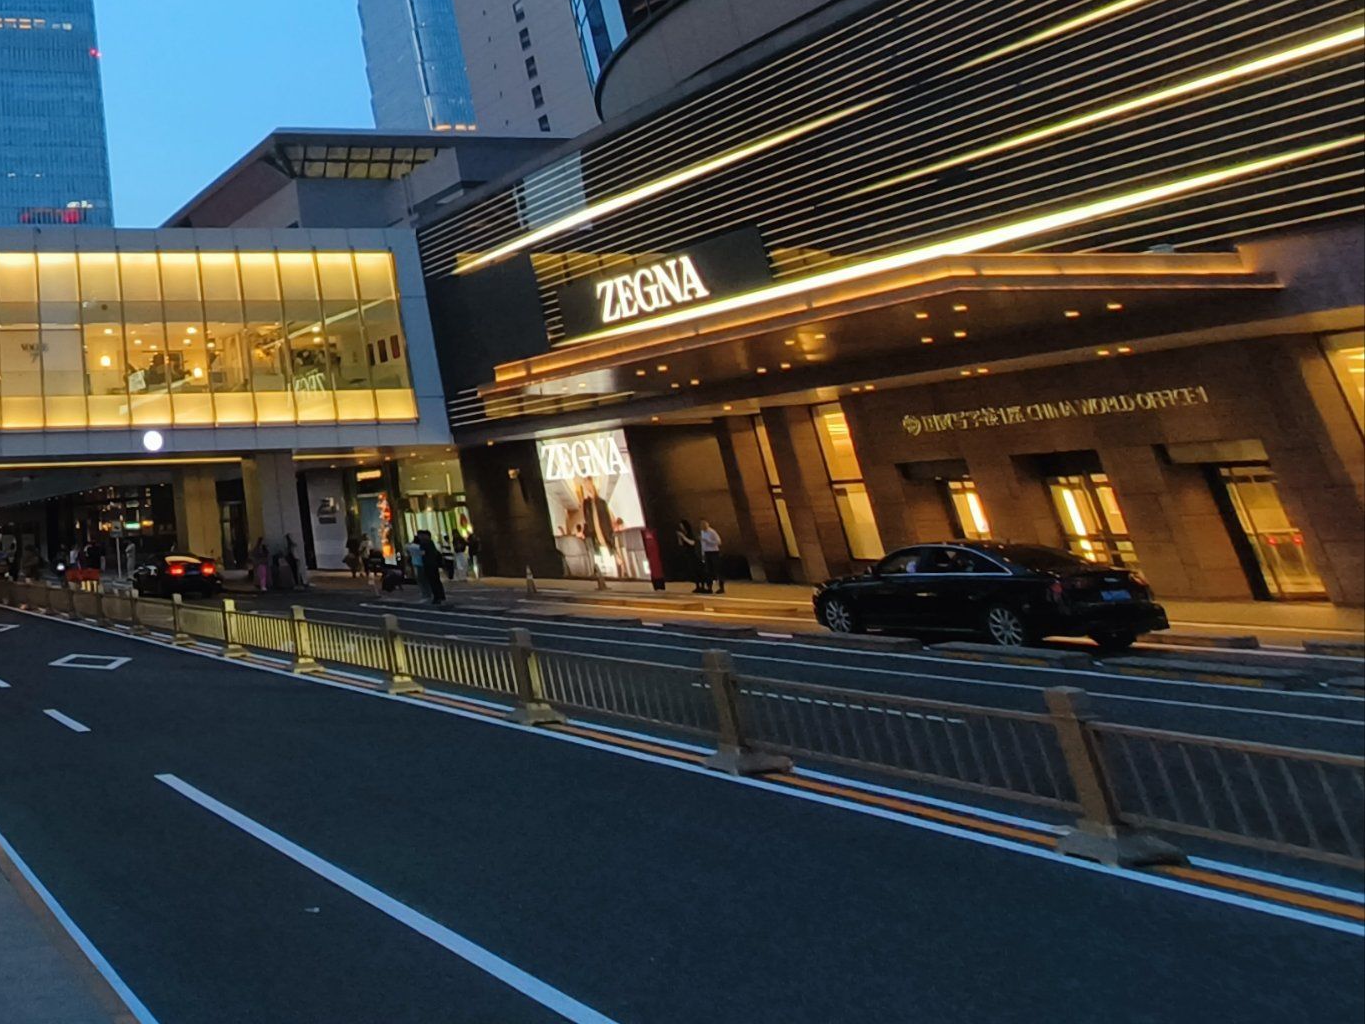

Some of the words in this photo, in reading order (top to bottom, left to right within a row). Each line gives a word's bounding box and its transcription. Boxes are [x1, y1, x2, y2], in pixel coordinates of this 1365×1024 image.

[596, 255, 710, 323] ZEGNA
[1026, 401, 1078, 422] CHINA
[1076, 394, 1134, 416] WORLD
[1136, 387, 1198, 410] OFFICE
[540, 437, 630, 481] ZEGNA
